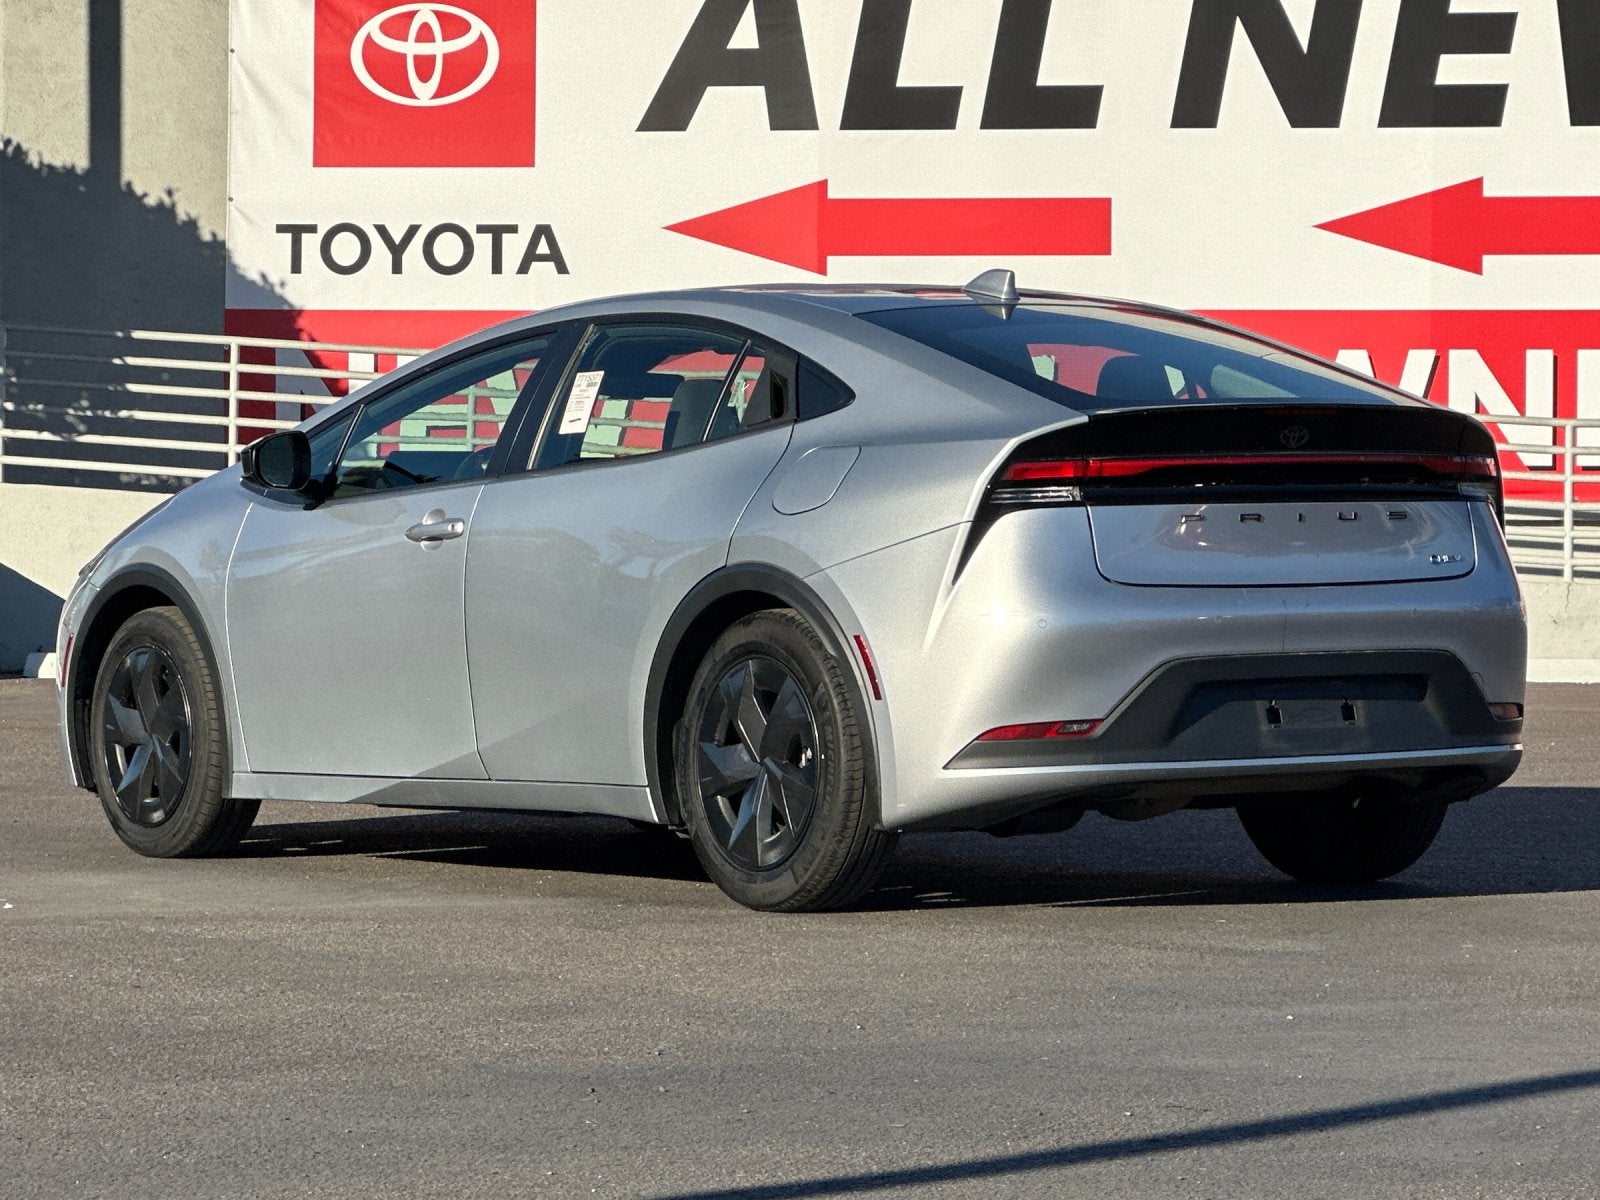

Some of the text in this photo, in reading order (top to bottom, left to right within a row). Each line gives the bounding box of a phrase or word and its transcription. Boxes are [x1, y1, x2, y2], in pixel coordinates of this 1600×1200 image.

[635, 0, 1600, 132] ALL NE
[275, 222, 570, 276] TOYOTA
[1180, 510, 1408, 523] PRIUS
